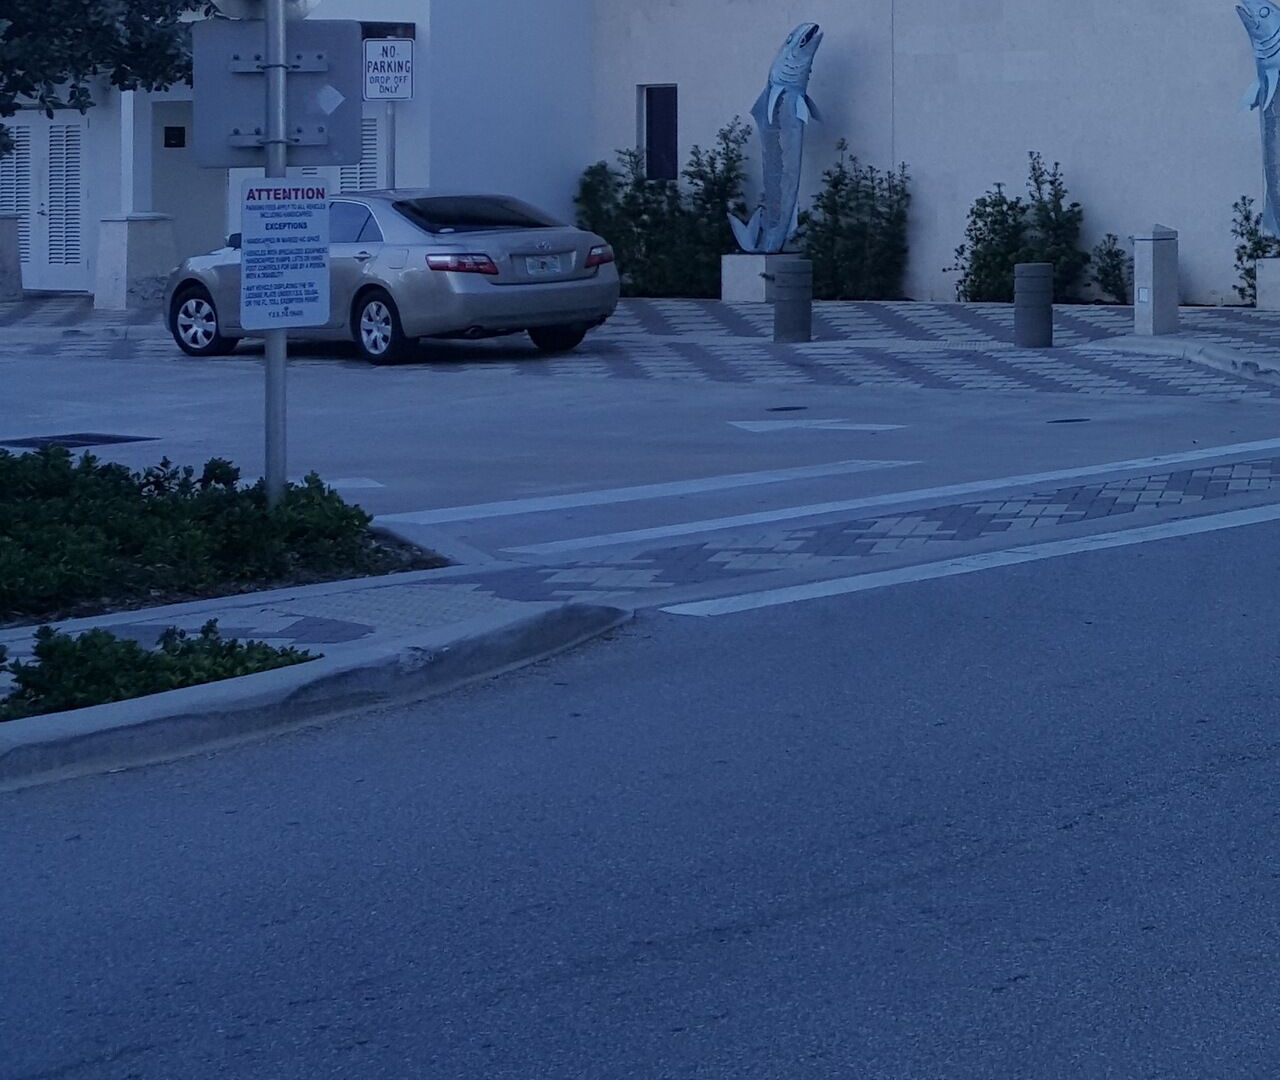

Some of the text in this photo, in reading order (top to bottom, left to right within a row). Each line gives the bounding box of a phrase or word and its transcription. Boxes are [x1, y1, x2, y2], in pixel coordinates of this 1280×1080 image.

[381, 45, 396, 58] NO
[367, 60, 411, 73] PARKING
[369, 75, 408, 85] DROP OFF
[379, 84, 399, 94] ONLY
[246, 187, 325, 201] ATTENTION
[265, 221, 308, 231] EXCEPTIONS
